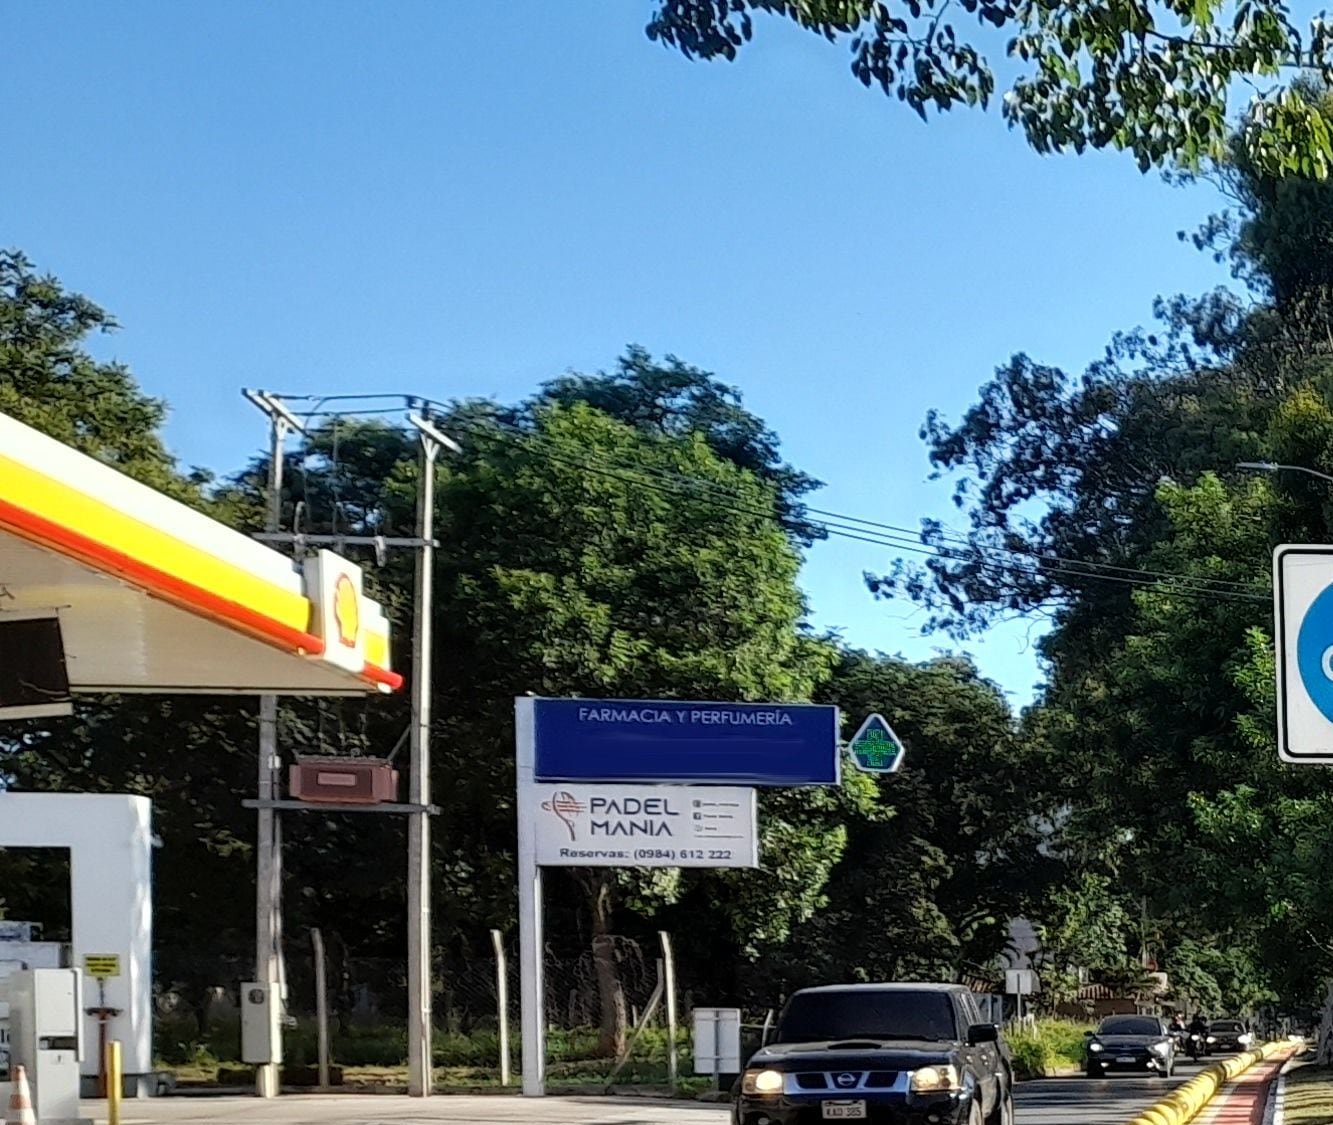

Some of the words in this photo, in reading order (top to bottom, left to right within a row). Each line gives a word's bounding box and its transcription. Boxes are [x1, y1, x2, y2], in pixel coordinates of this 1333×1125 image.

[579, 708, 671, 723] FARMACIA
[677, 710, 685, 723] Y
[691, 709, 792, 726] PERFUMERÍA
[590, 798, 680, 815] PADEL
[590, 820, 672, 836] MANIA
[560, 848, 629, 859] Reservas:
[634, 849, 675, 860] (0984)
[680, 850, 704, 859] 612
[708, 850, 732, 860] 222
